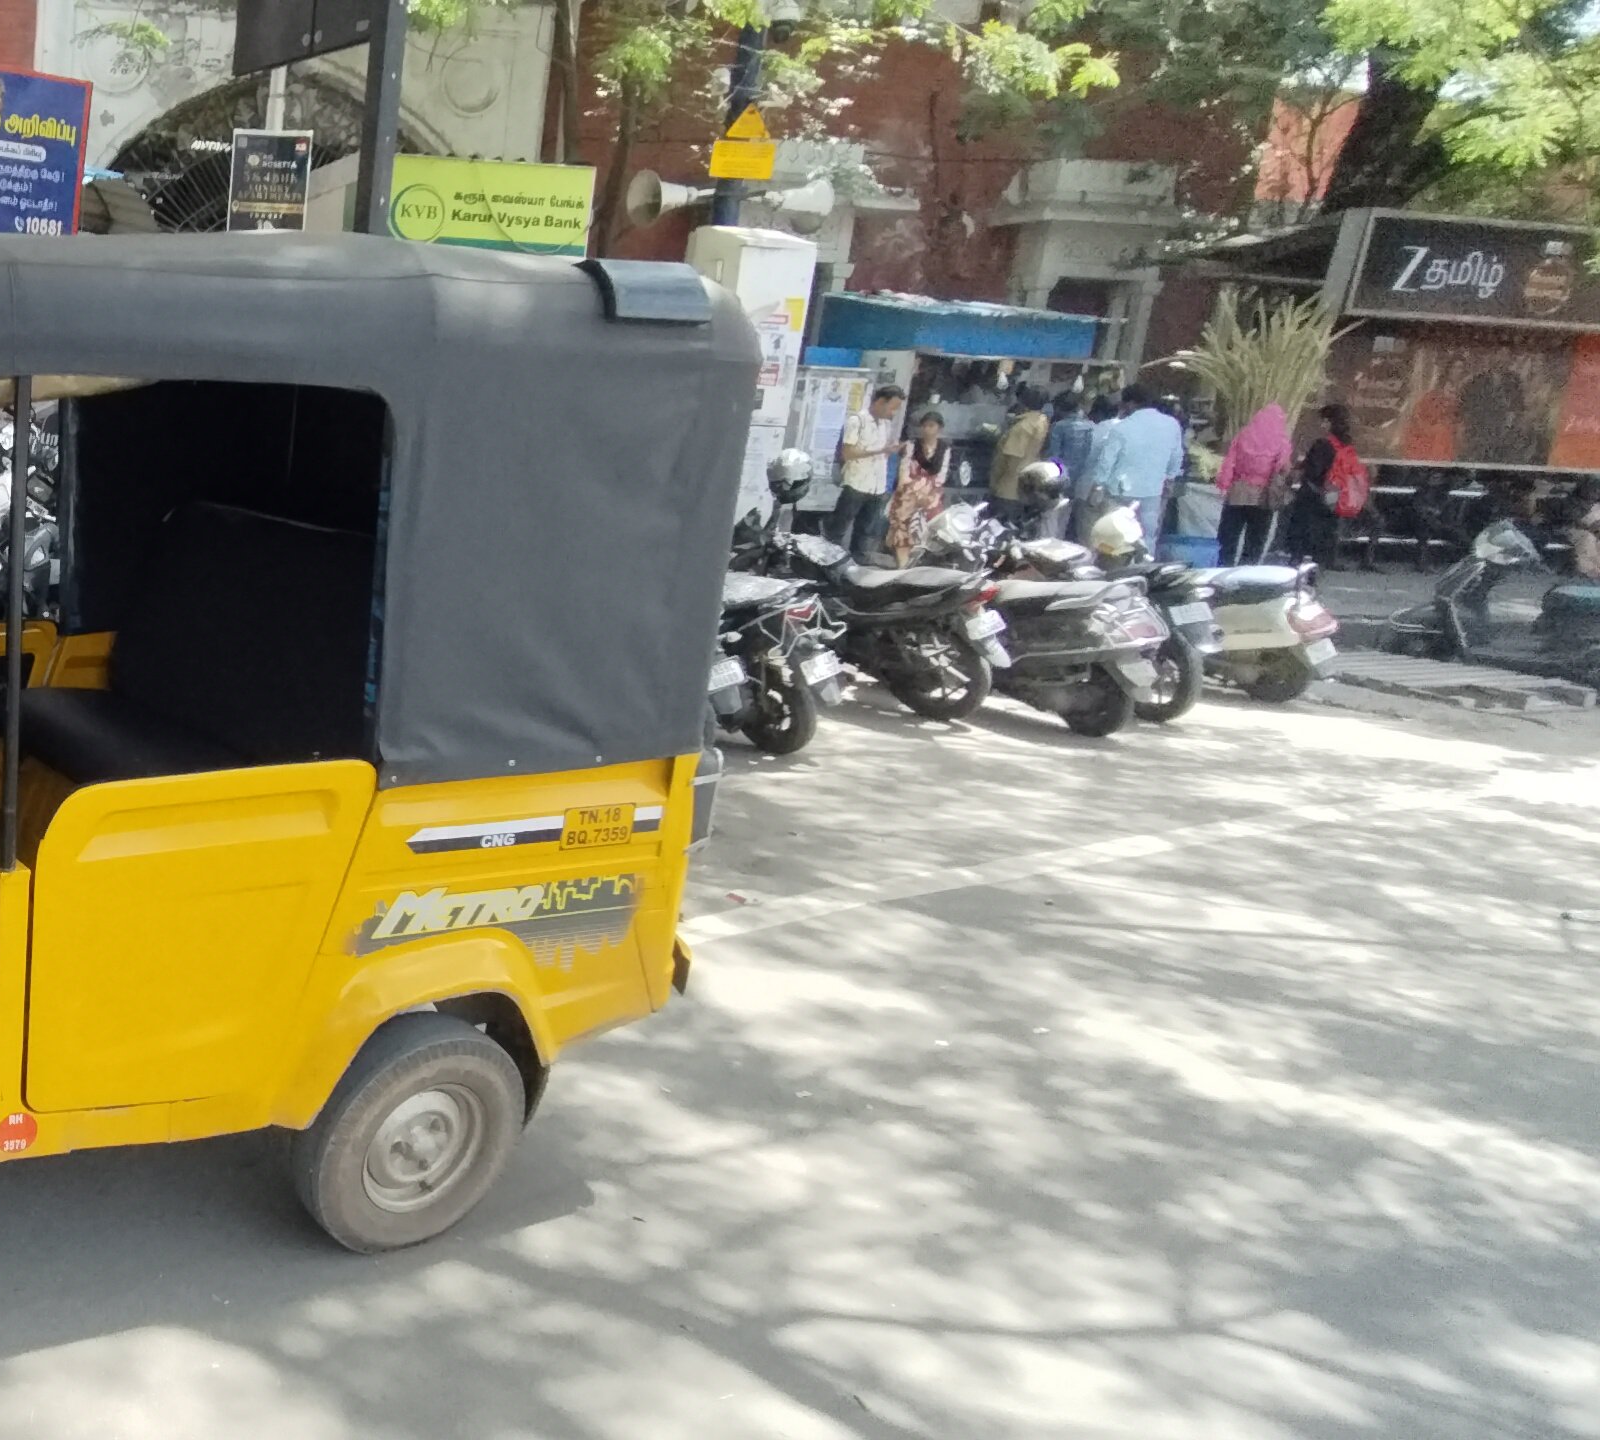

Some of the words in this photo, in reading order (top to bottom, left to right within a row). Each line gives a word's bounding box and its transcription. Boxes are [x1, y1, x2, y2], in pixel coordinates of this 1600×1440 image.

[4, 114, 77, 147] அறிவிப்பு
[400, 203, 438, 220] KVB
[451, 209, 493, 223] Karur
[497, 212, 540, 229] Vysya
[544, 215, 582, 230] Bank
[1419, 250, 1505, 299] தமிழ்
[578, 808, 622, 826] TN.18
[480, 833, 516, 849] CNG
[566, 826, 628, 845] BQ.7359
[371, 884, 545, 939] METRO
[8, 1113, 24, 1126] RH
